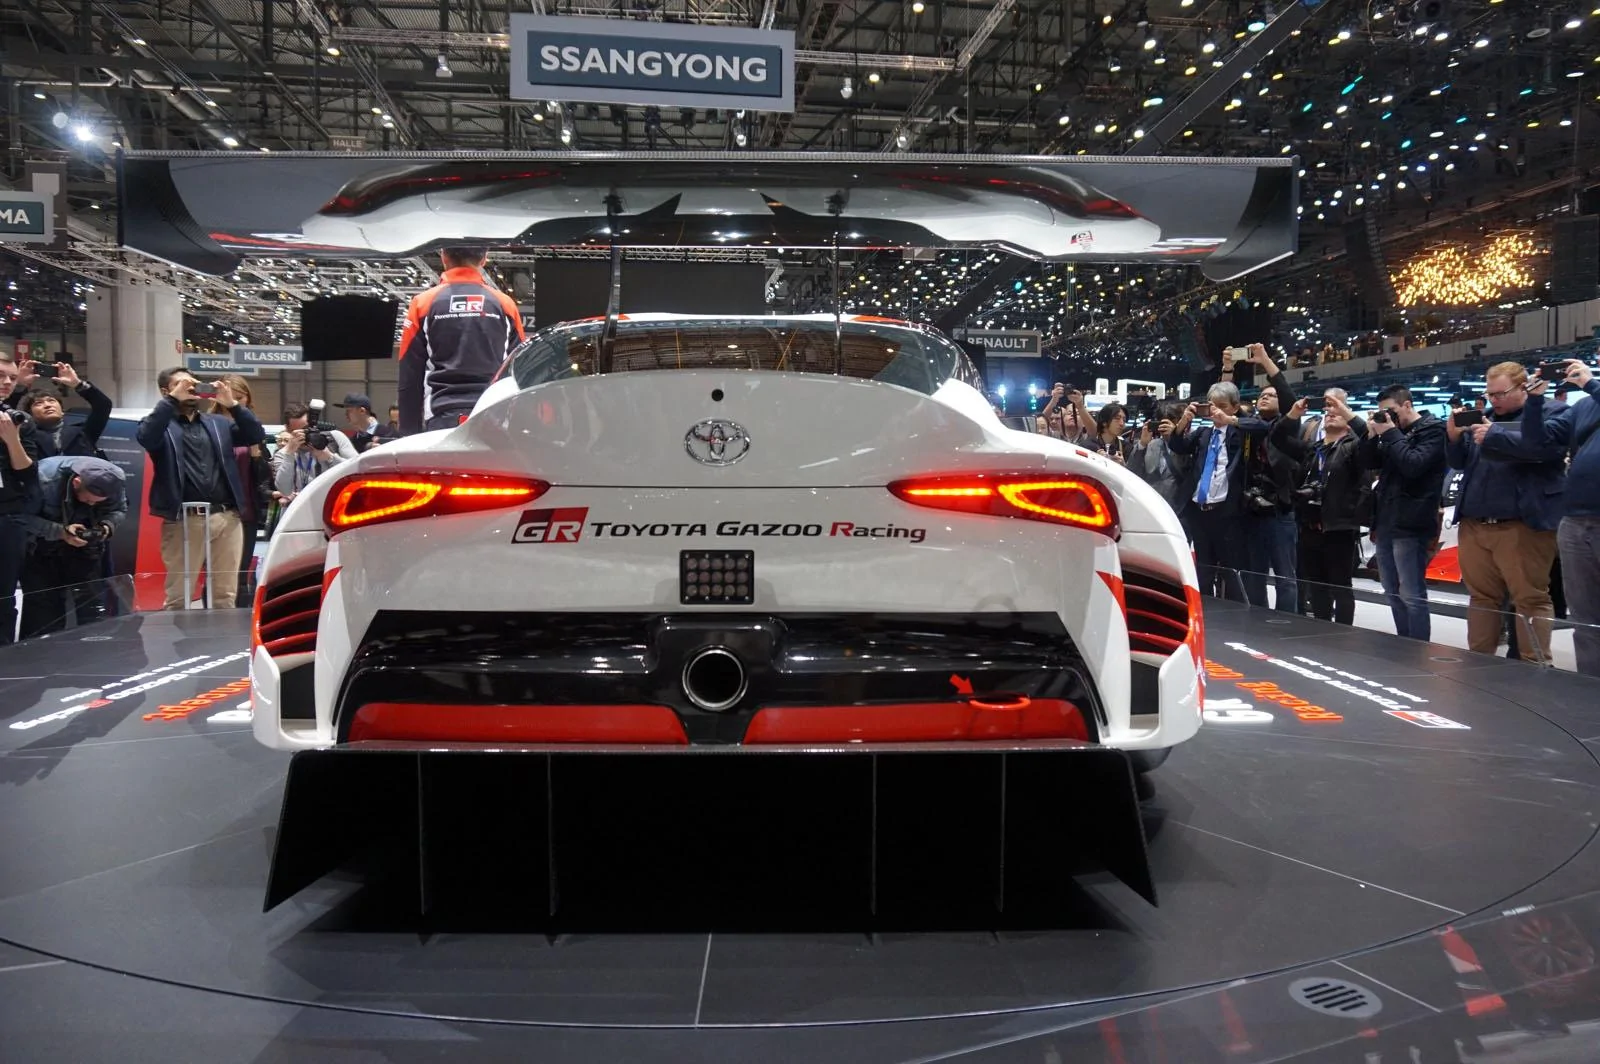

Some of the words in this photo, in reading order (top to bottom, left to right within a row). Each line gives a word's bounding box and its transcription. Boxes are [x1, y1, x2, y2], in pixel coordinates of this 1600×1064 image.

[540, 44, 767, 83] SSANGYONG
[451, 301, 483, 311] GR
[967, 337, 1029, 349] RENAULT
[244, 351, 297, 362] KLASSEN
[199, 360, 241, 369] SUZU
[514, 520, 583, 543] GR
[591, 522, 706, 537] TOYOTA
[716, 521, 823, 537] GAZOO
[830, 521, 926, 544] Racing
